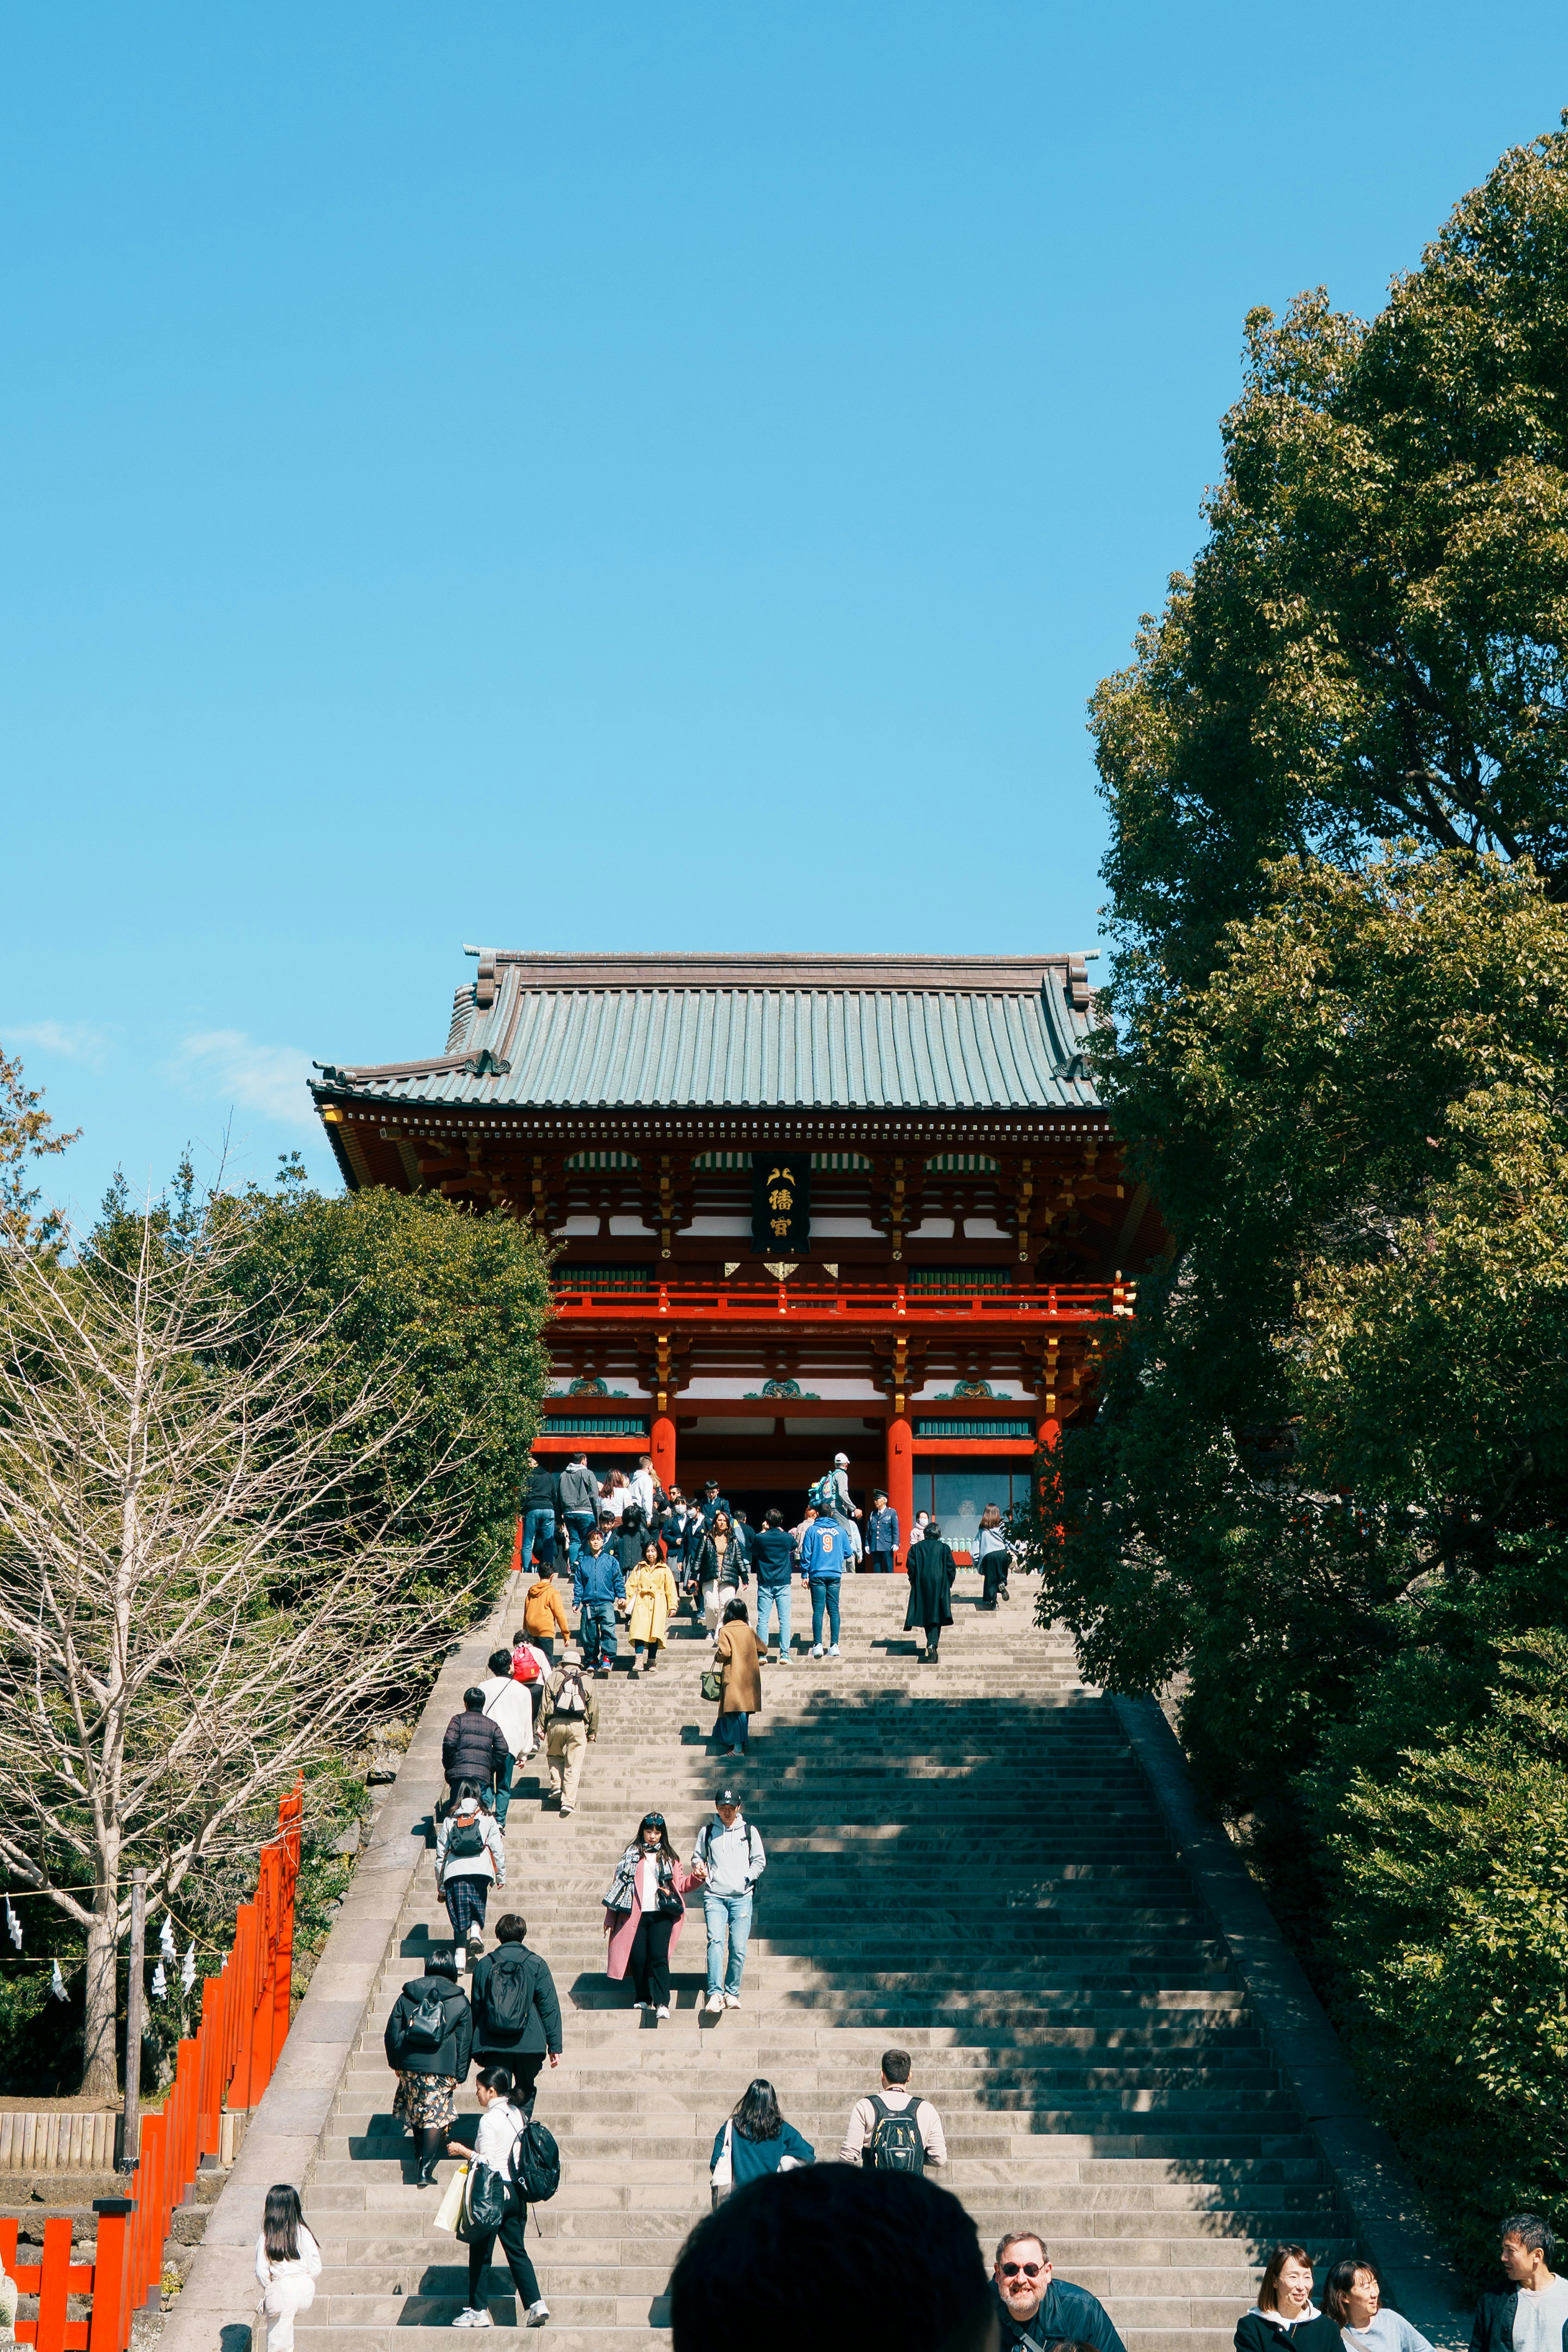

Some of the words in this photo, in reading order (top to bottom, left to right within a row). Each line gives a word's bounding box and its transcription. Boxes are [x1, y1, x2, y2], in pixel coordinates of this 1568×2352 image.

[766, 1168, 796, 1237] 八幡宮
[822, 1534, 833, 1552] 9
